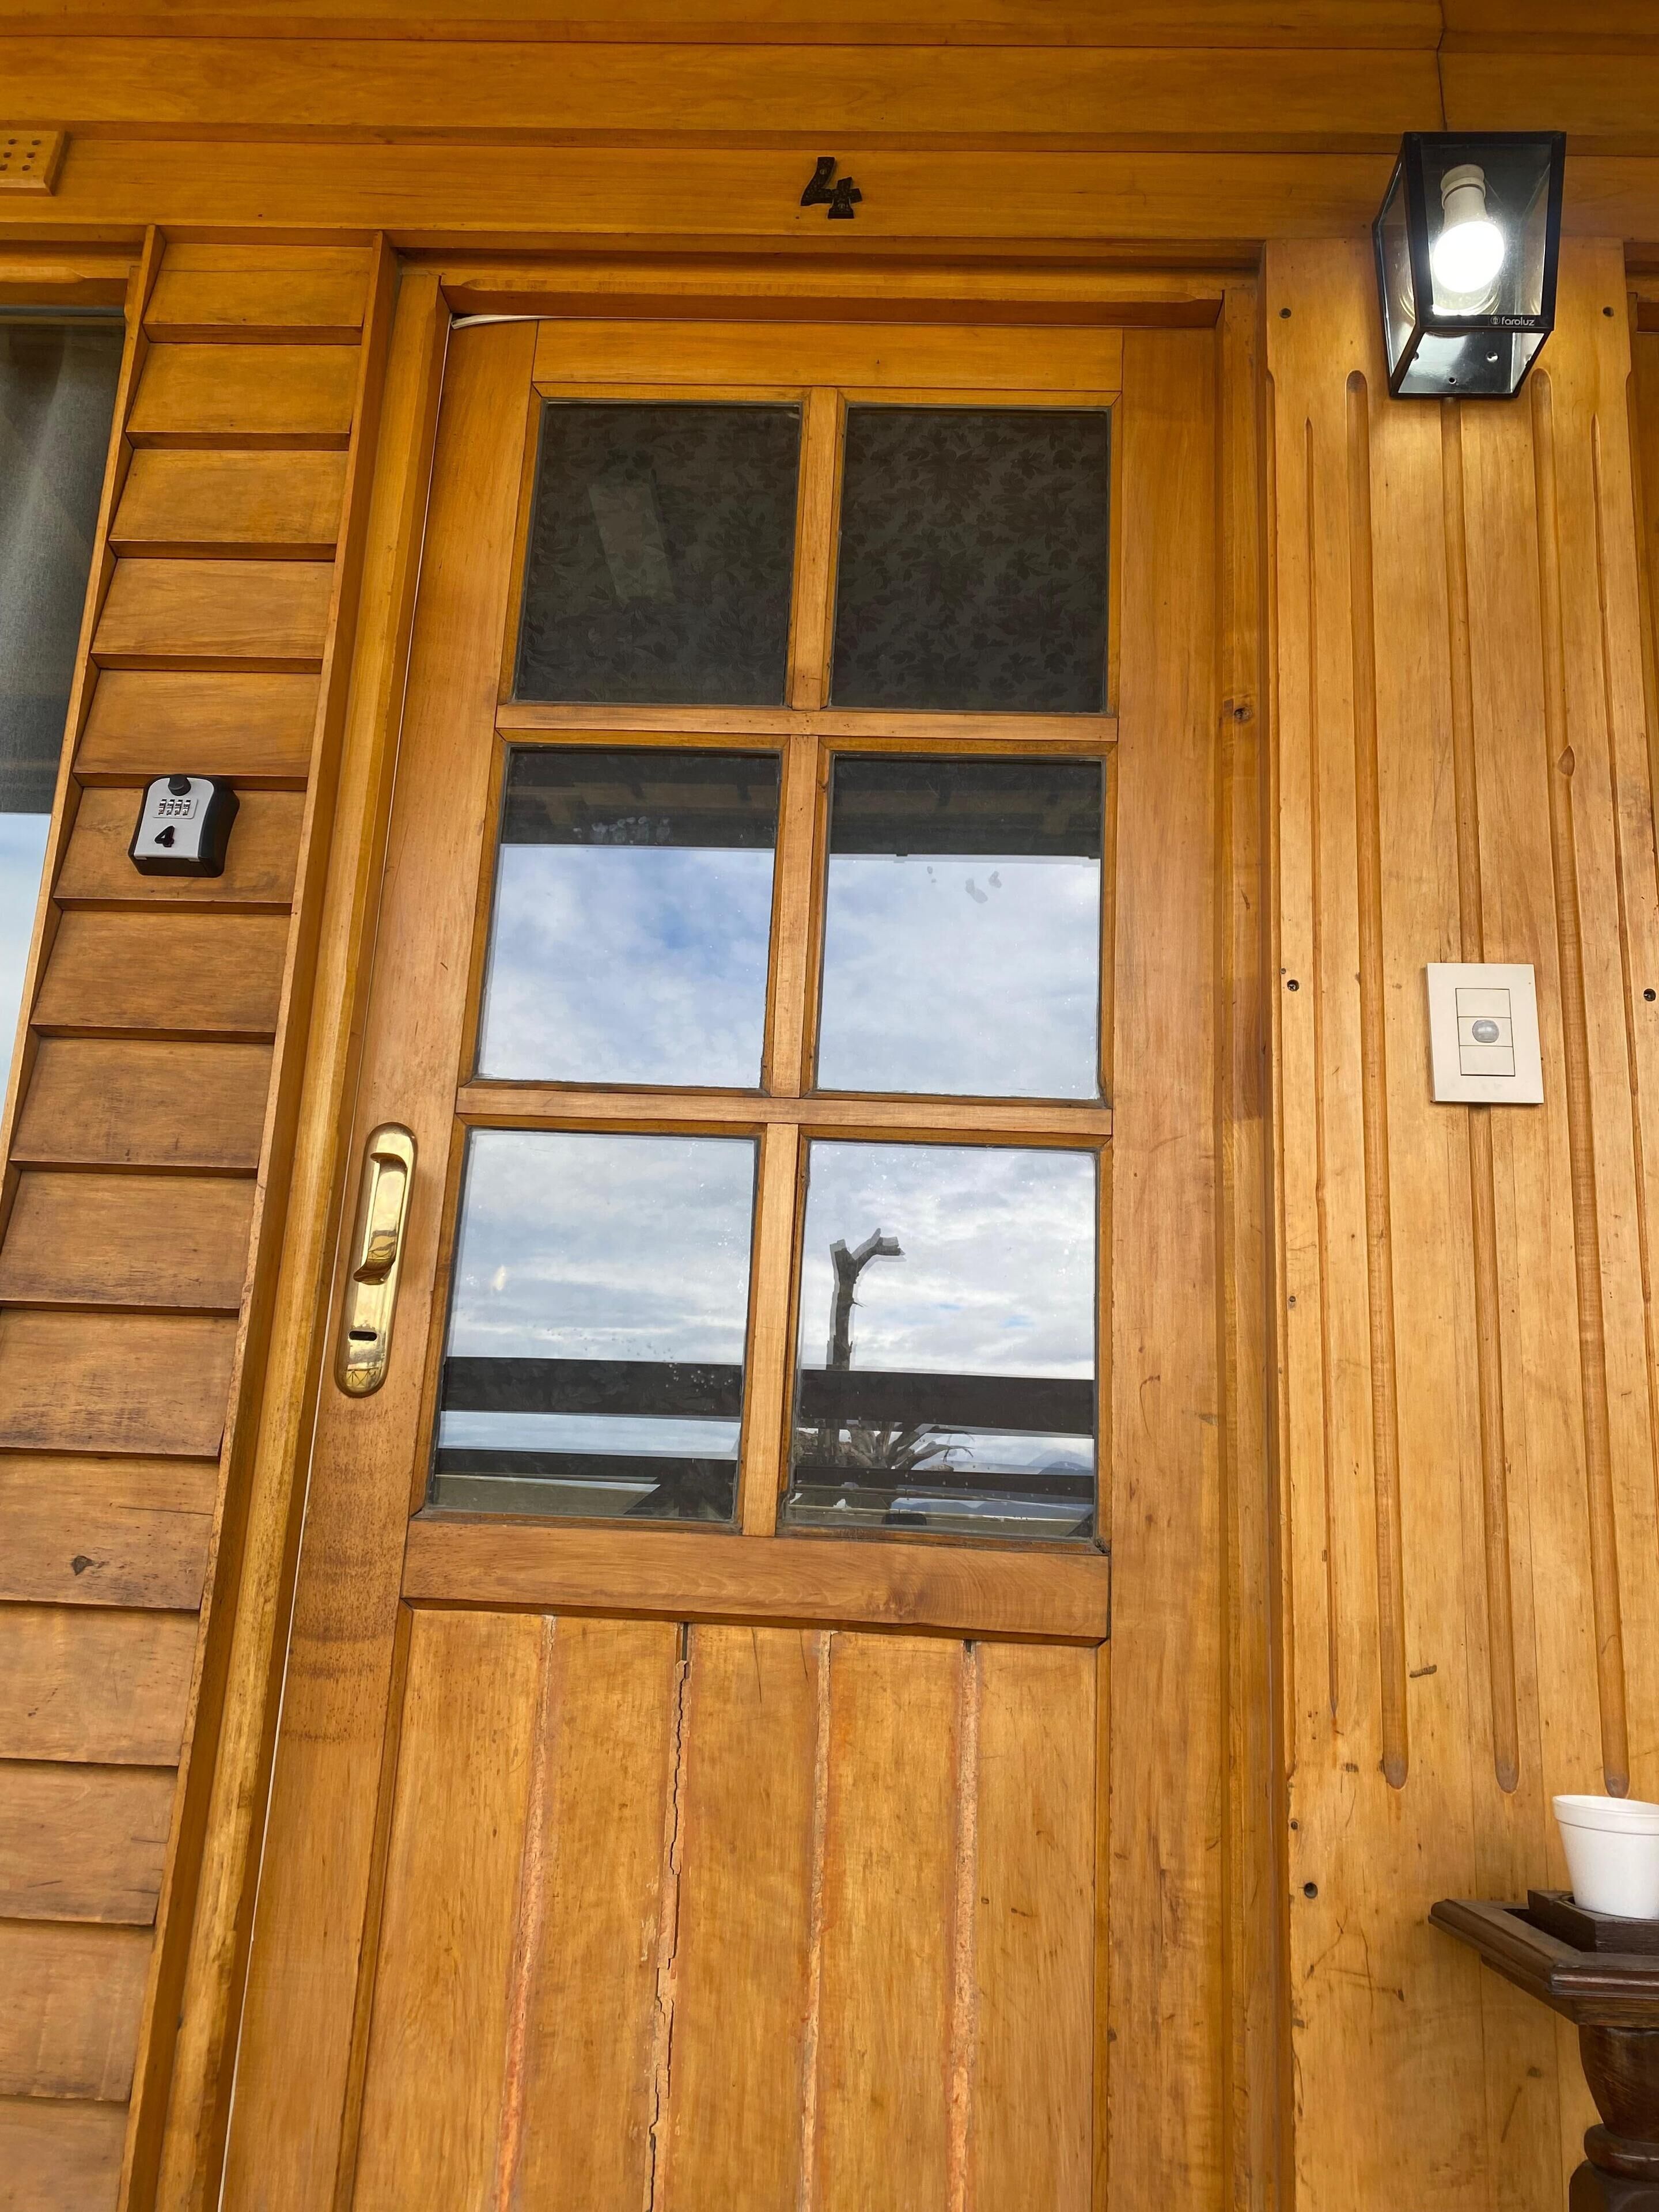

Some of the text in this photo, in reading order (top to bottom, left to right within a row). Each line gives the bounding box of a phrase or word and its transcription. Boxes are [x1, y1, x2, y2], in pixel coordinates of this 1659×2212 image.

[800, 156, 863, 219] 4
[1501, 316, 1535, 326] faroluz
[154, 825, 175, 847] 4
